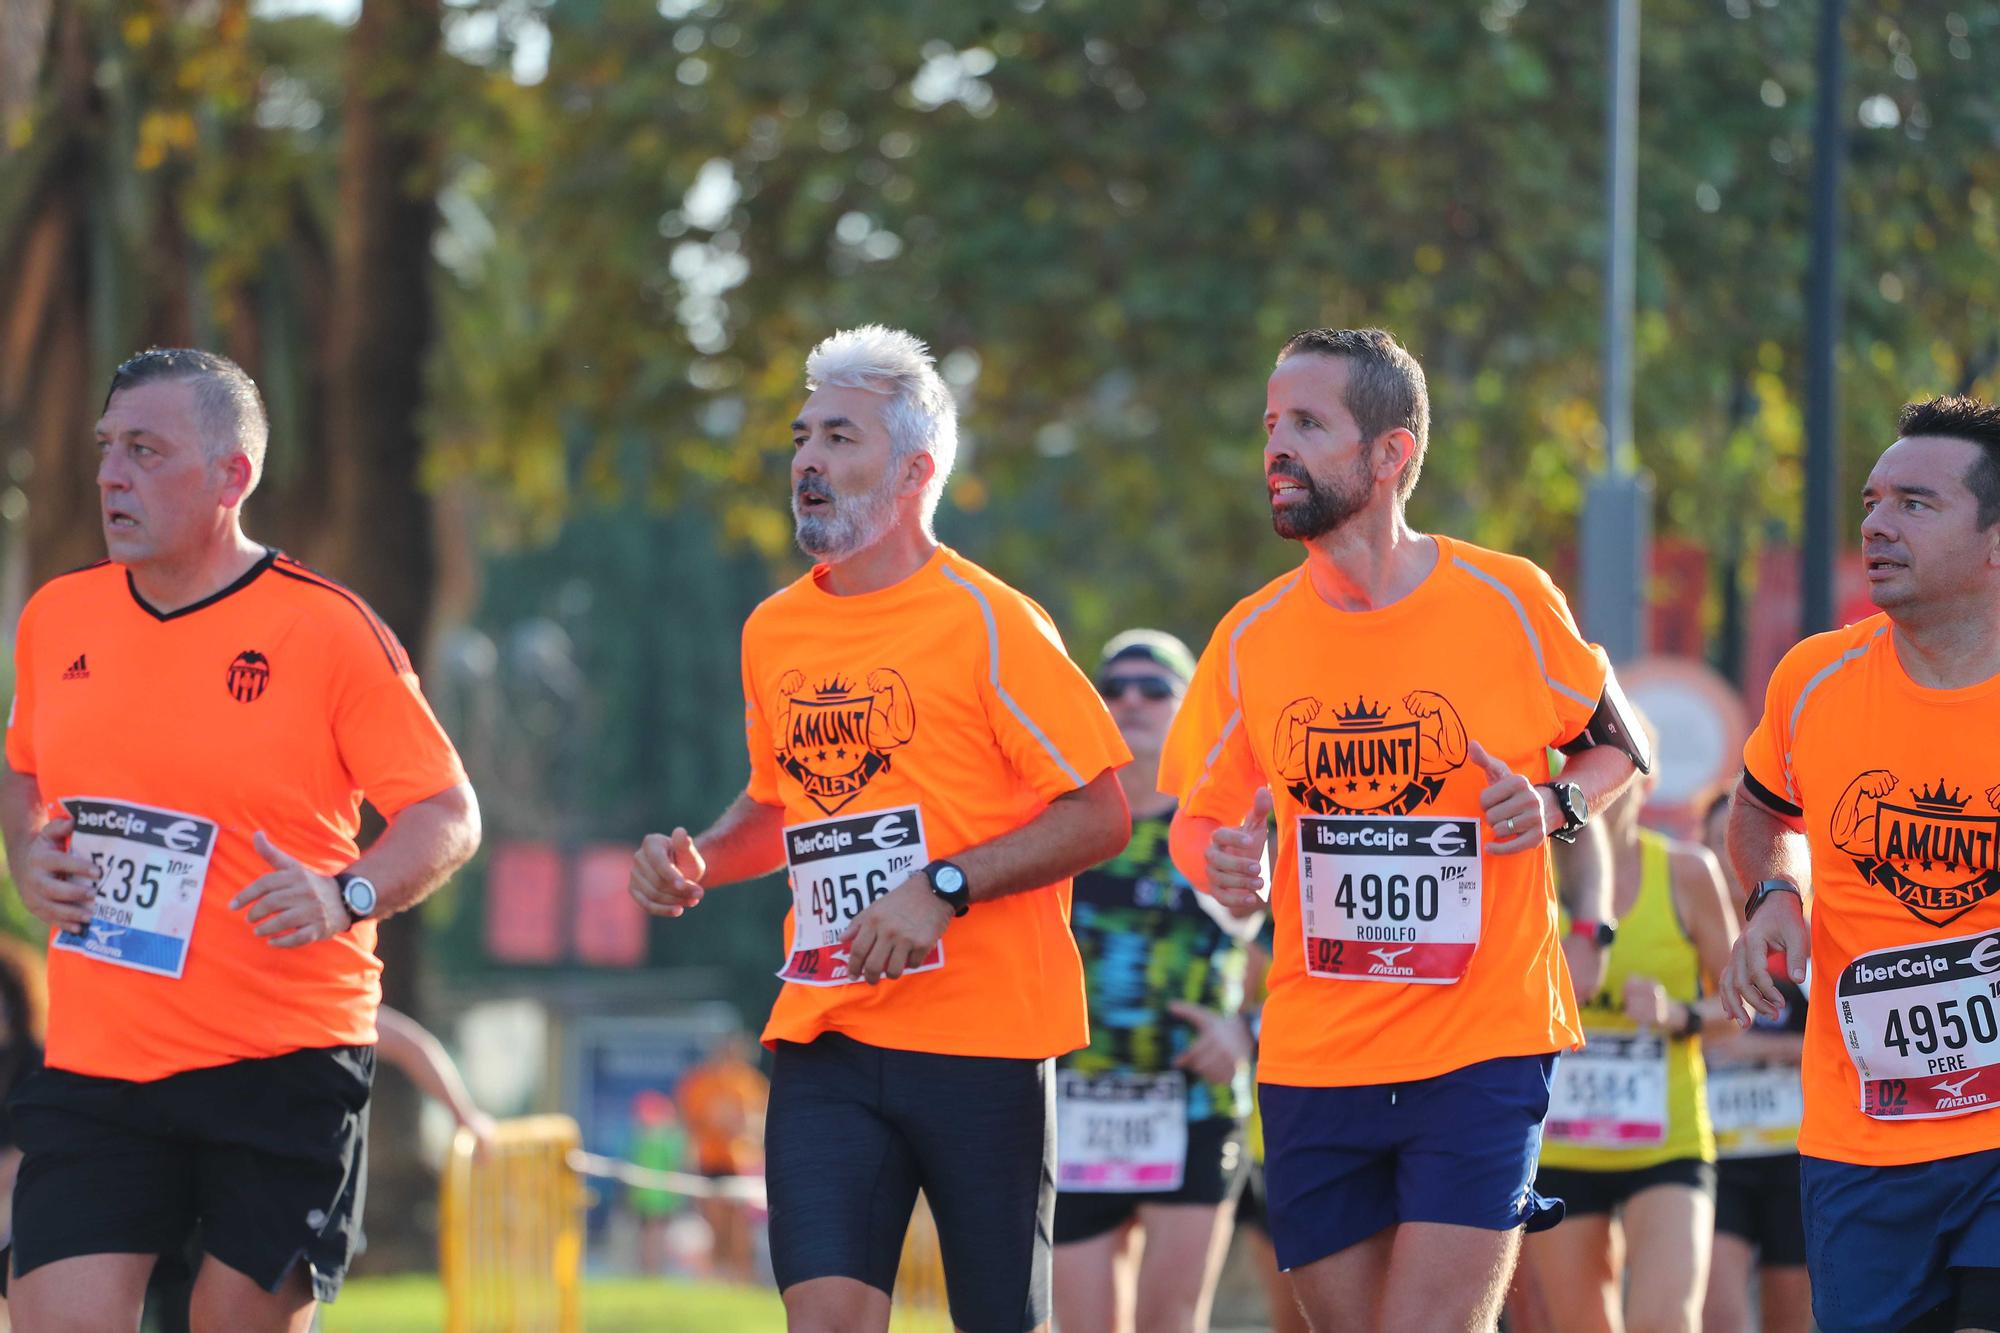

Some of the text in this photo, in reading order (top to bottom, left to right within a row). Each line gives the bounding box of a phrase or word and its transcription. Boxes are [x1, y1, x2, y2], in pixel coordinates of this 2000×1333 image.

[793, 711, 865, 748] AMUNT
[1316, 738, 1412, 779] AMUNT
[799, 762, 870, 797] VALENT
[794, 828, 853, 853] iberCaja
[1316, 826, 1409, 851] iberCaja
[1886, 820, 1992, 869] AMUNT
[888, 855, 914, 873] 10K
[1441, 866, 1467, 881] 10K
[1334, 873, 1439, 922] 4960
[1892, 876, 1989, 908] VALENT
[1357, 926, 1416, 942] RODOLFO
[798, 949, 819, 974] 02
[1319, 939, 1344, 965] 02
[1855, 954, 1949, 984] iberCaja
[1884, 994, 1998, 1057] 4950
[1927, 1054, 1967, 1075] PERE
[1879, 1078, 1908, 1107] 02
